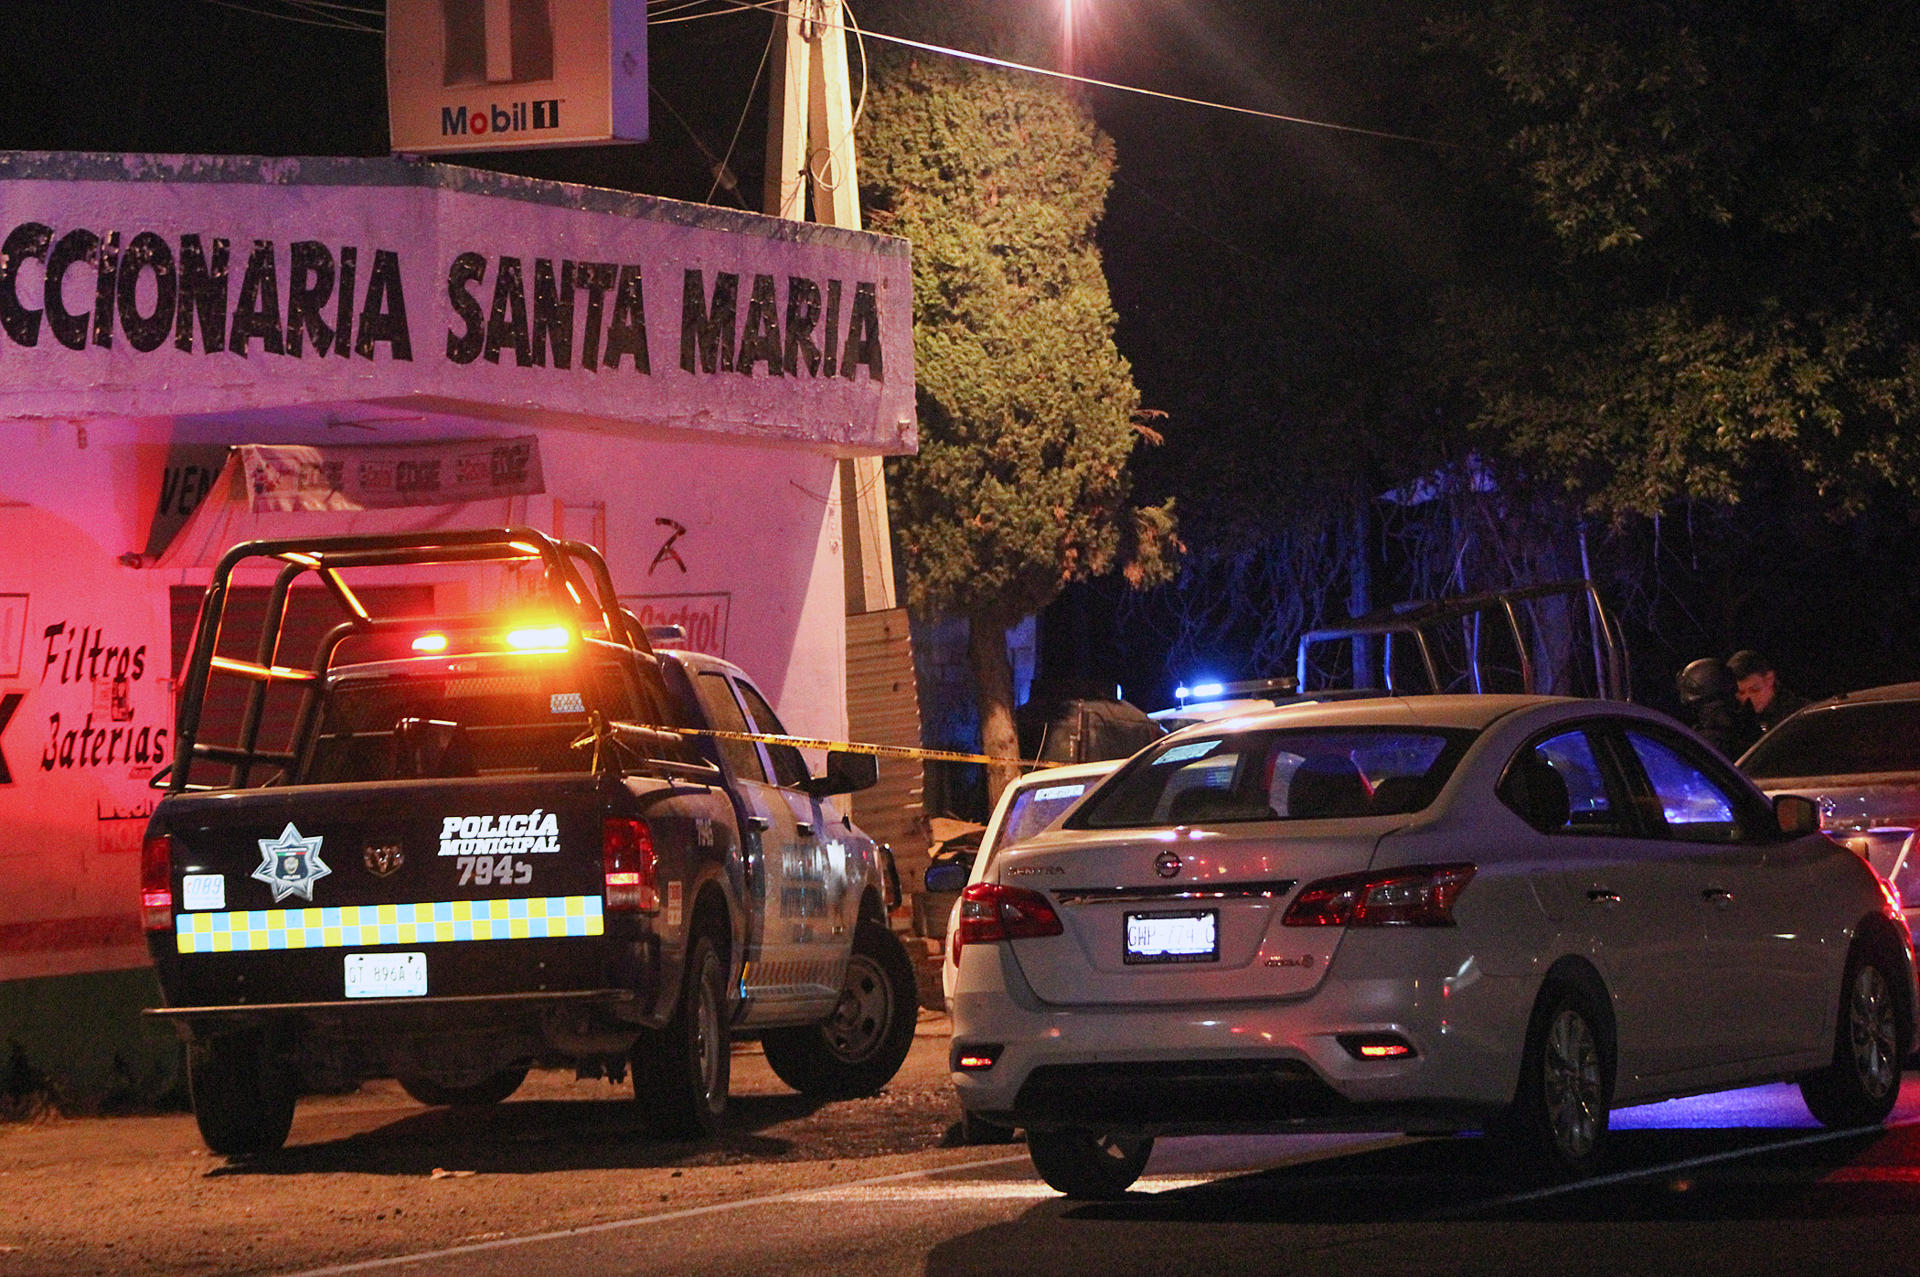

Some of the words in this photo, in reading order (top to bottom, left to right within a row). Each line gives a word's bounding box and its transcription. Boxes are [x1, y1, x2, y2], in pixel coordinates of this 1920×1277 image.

[442, 102, 526, 136] Mobil
[0, 222, 413, 362] CCIONARIA
[446, 251, 651, 376] SANTA
[680, 268, 884, 382] MARIA
[40, 620, 146, 689] Filtros
[439, 808, 560, 840] POLICÍA
[437, 836, 560, 856] MUNICIPAL
